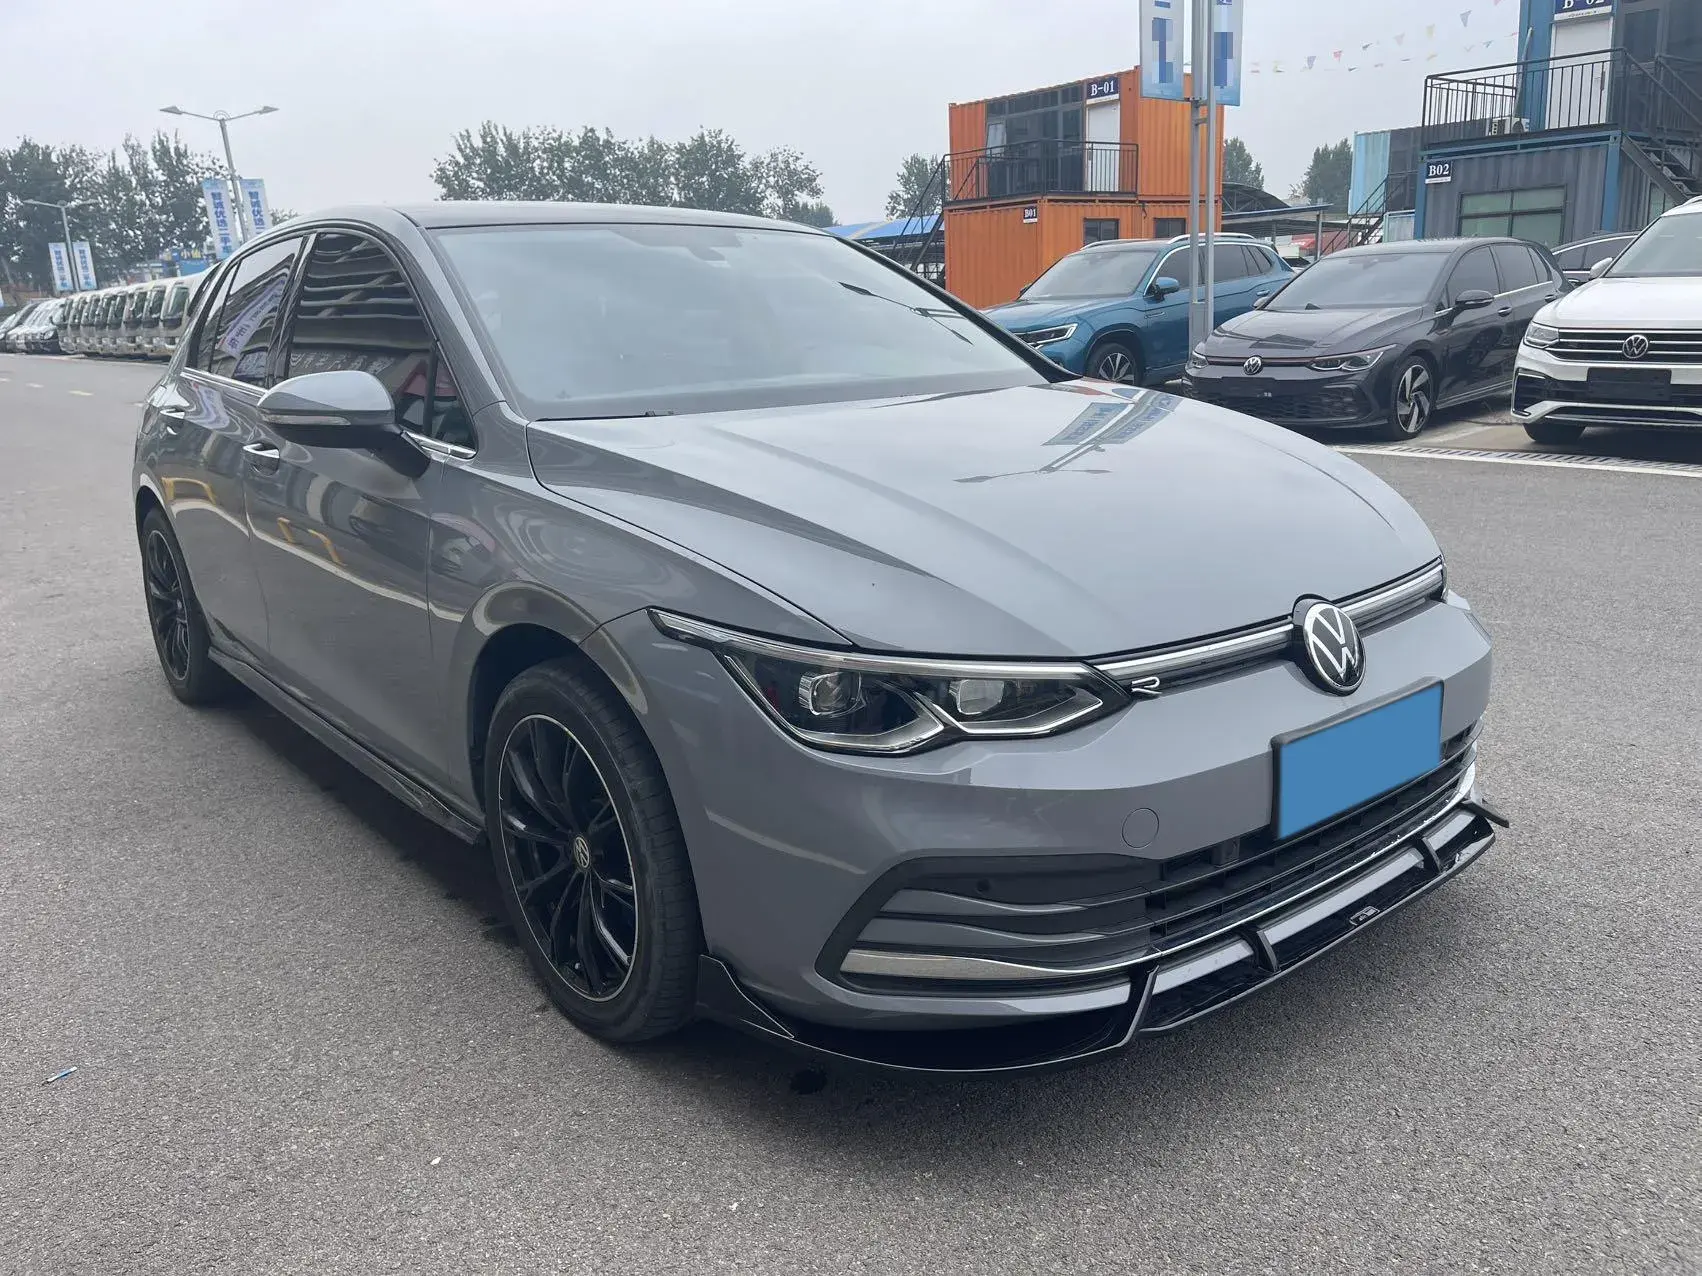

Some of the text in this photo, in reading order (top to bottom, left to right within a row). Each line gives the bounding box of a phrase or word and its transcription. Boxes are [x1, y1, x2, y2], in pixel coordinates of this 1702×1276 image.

[1090, 80, 1115, 96] B-01
[1428, 163, 1450, 177] B02
[1024, 208, 1037, 218] B01
